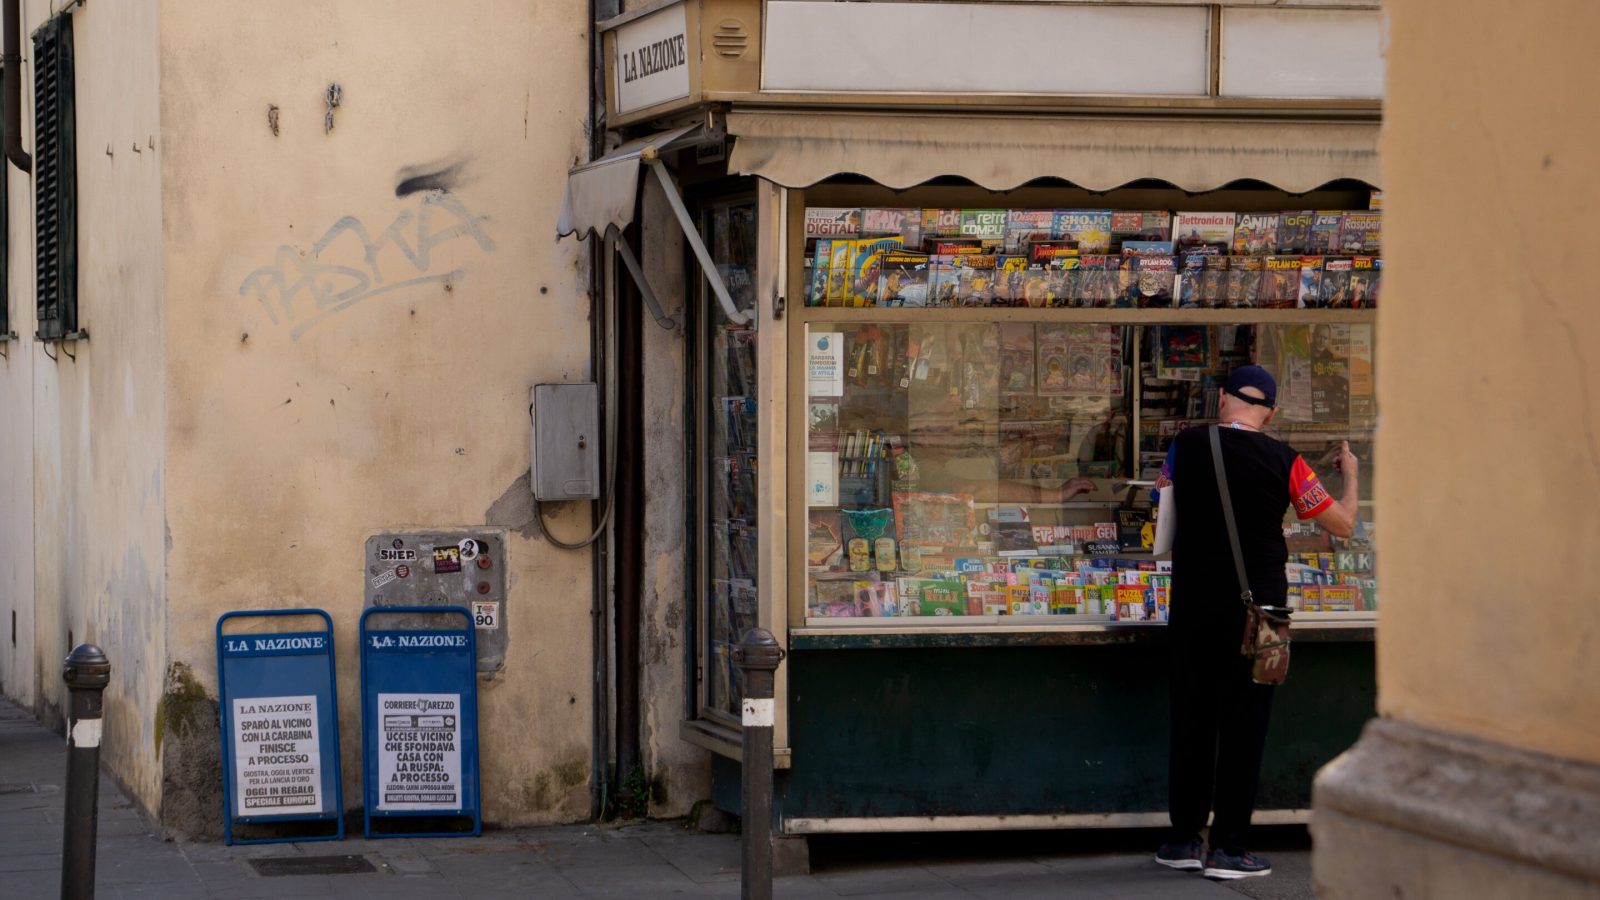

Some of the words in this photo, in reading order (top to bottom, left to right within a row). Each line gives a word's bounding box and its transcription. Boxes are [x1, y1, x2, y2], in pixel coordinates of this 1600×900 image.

[624, 53, 638, 83] LA
[639, 34, 686, 78] NAZIONE
[1060, 214, 1108, 225] SHOJO
[1179, 216, 1224, 225] Elettronica
[807, 223, 860, 234] DIGITALE
[1267, 260, 1290, 268] DYLAN
[380, 550, 415, 560] SHEP
[962, 562, 984, 572] Cura
[476, 616, 494, 626] 90
[228, 640, 249, 652] LA
[255, 638, 324, 650] NAZIONE
[372, 635, 393, 648] LA
[398, 635, 466, 646] NAZIONE
[240, 706, 256, 714] LA
[258, 703, 312, 713] NAZIONE
[384, 701, 416, 709] CORRIERE
[428, 701, 455, 709] AREZZO
[241, 718, 270, 730] SPARÒ
[271, 720, 281, 729] AL
[283, 718, 312, 728] VICINO
[242, 732, 259, 742] CON
[260, 732, 270, 742] LA
[272, 730, 312, 741] CARABINA
[386, 732, 418, 741] UCCISE
[420, 732, 454, 741] VICINO
[260, 743, 296, 754] FINISCE
[384, 742, 402, 751] CHE
[404, 742, 455, 751] SFONDAVA
[248, 757, 255, 765] A
[257, 754, 309, 765] PROCESSO
[396, 752, 421, 762] CASA
[424, 752, 444, 762] CON
[397, 763, 408, 772] LA
[410, 763, 444, 772] RUSPA:
[392, 773, 398, 782] A
[400, 773, 449, 782] PROCESSO
[246, 788, 267, 796] OGGI
[281, 785, 314, 794] REGALO
[246, 797, 282, 807] SPECIALE
[283, 796, 314, 804] EUROPEI
